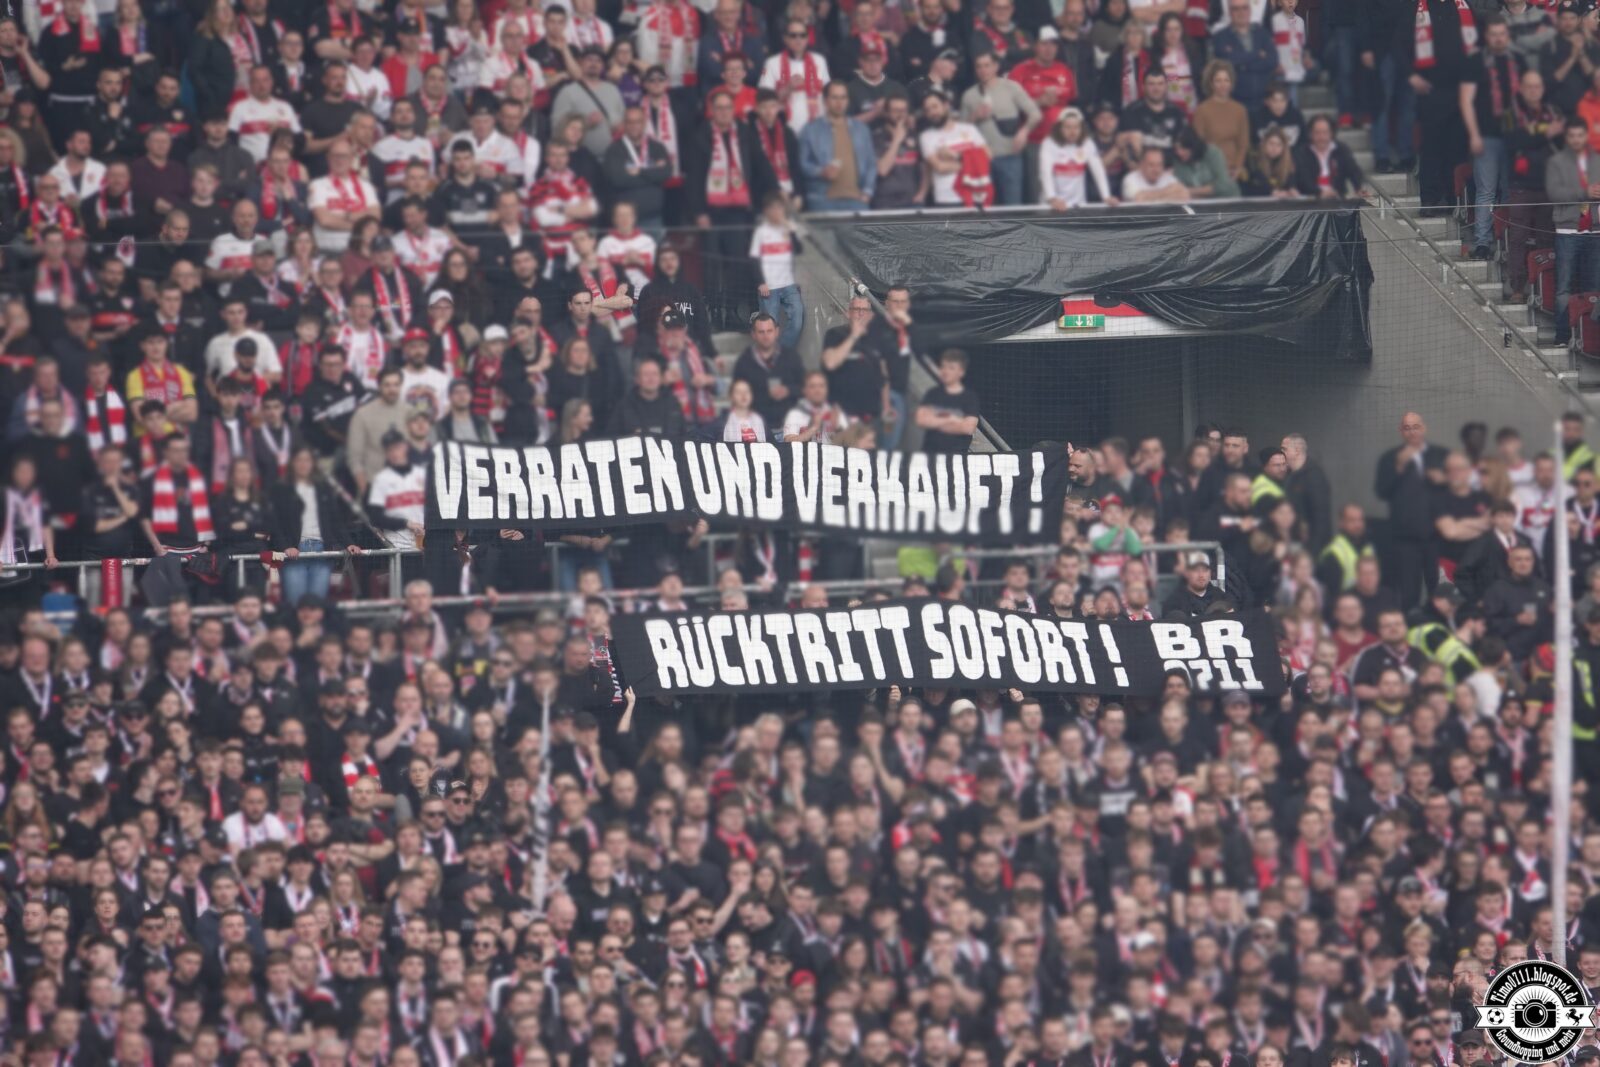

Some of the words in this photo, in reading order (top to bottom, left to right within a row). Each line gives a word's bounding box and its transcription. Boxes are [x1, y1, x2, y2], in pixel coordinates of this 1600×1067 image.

[432, 436, 685, 520] VERRATEN
[684, 440, 783, 521] UND
[645, 605, 914, 689] RÜCKTRITT
[1150, 619, 1254, 659] BR
